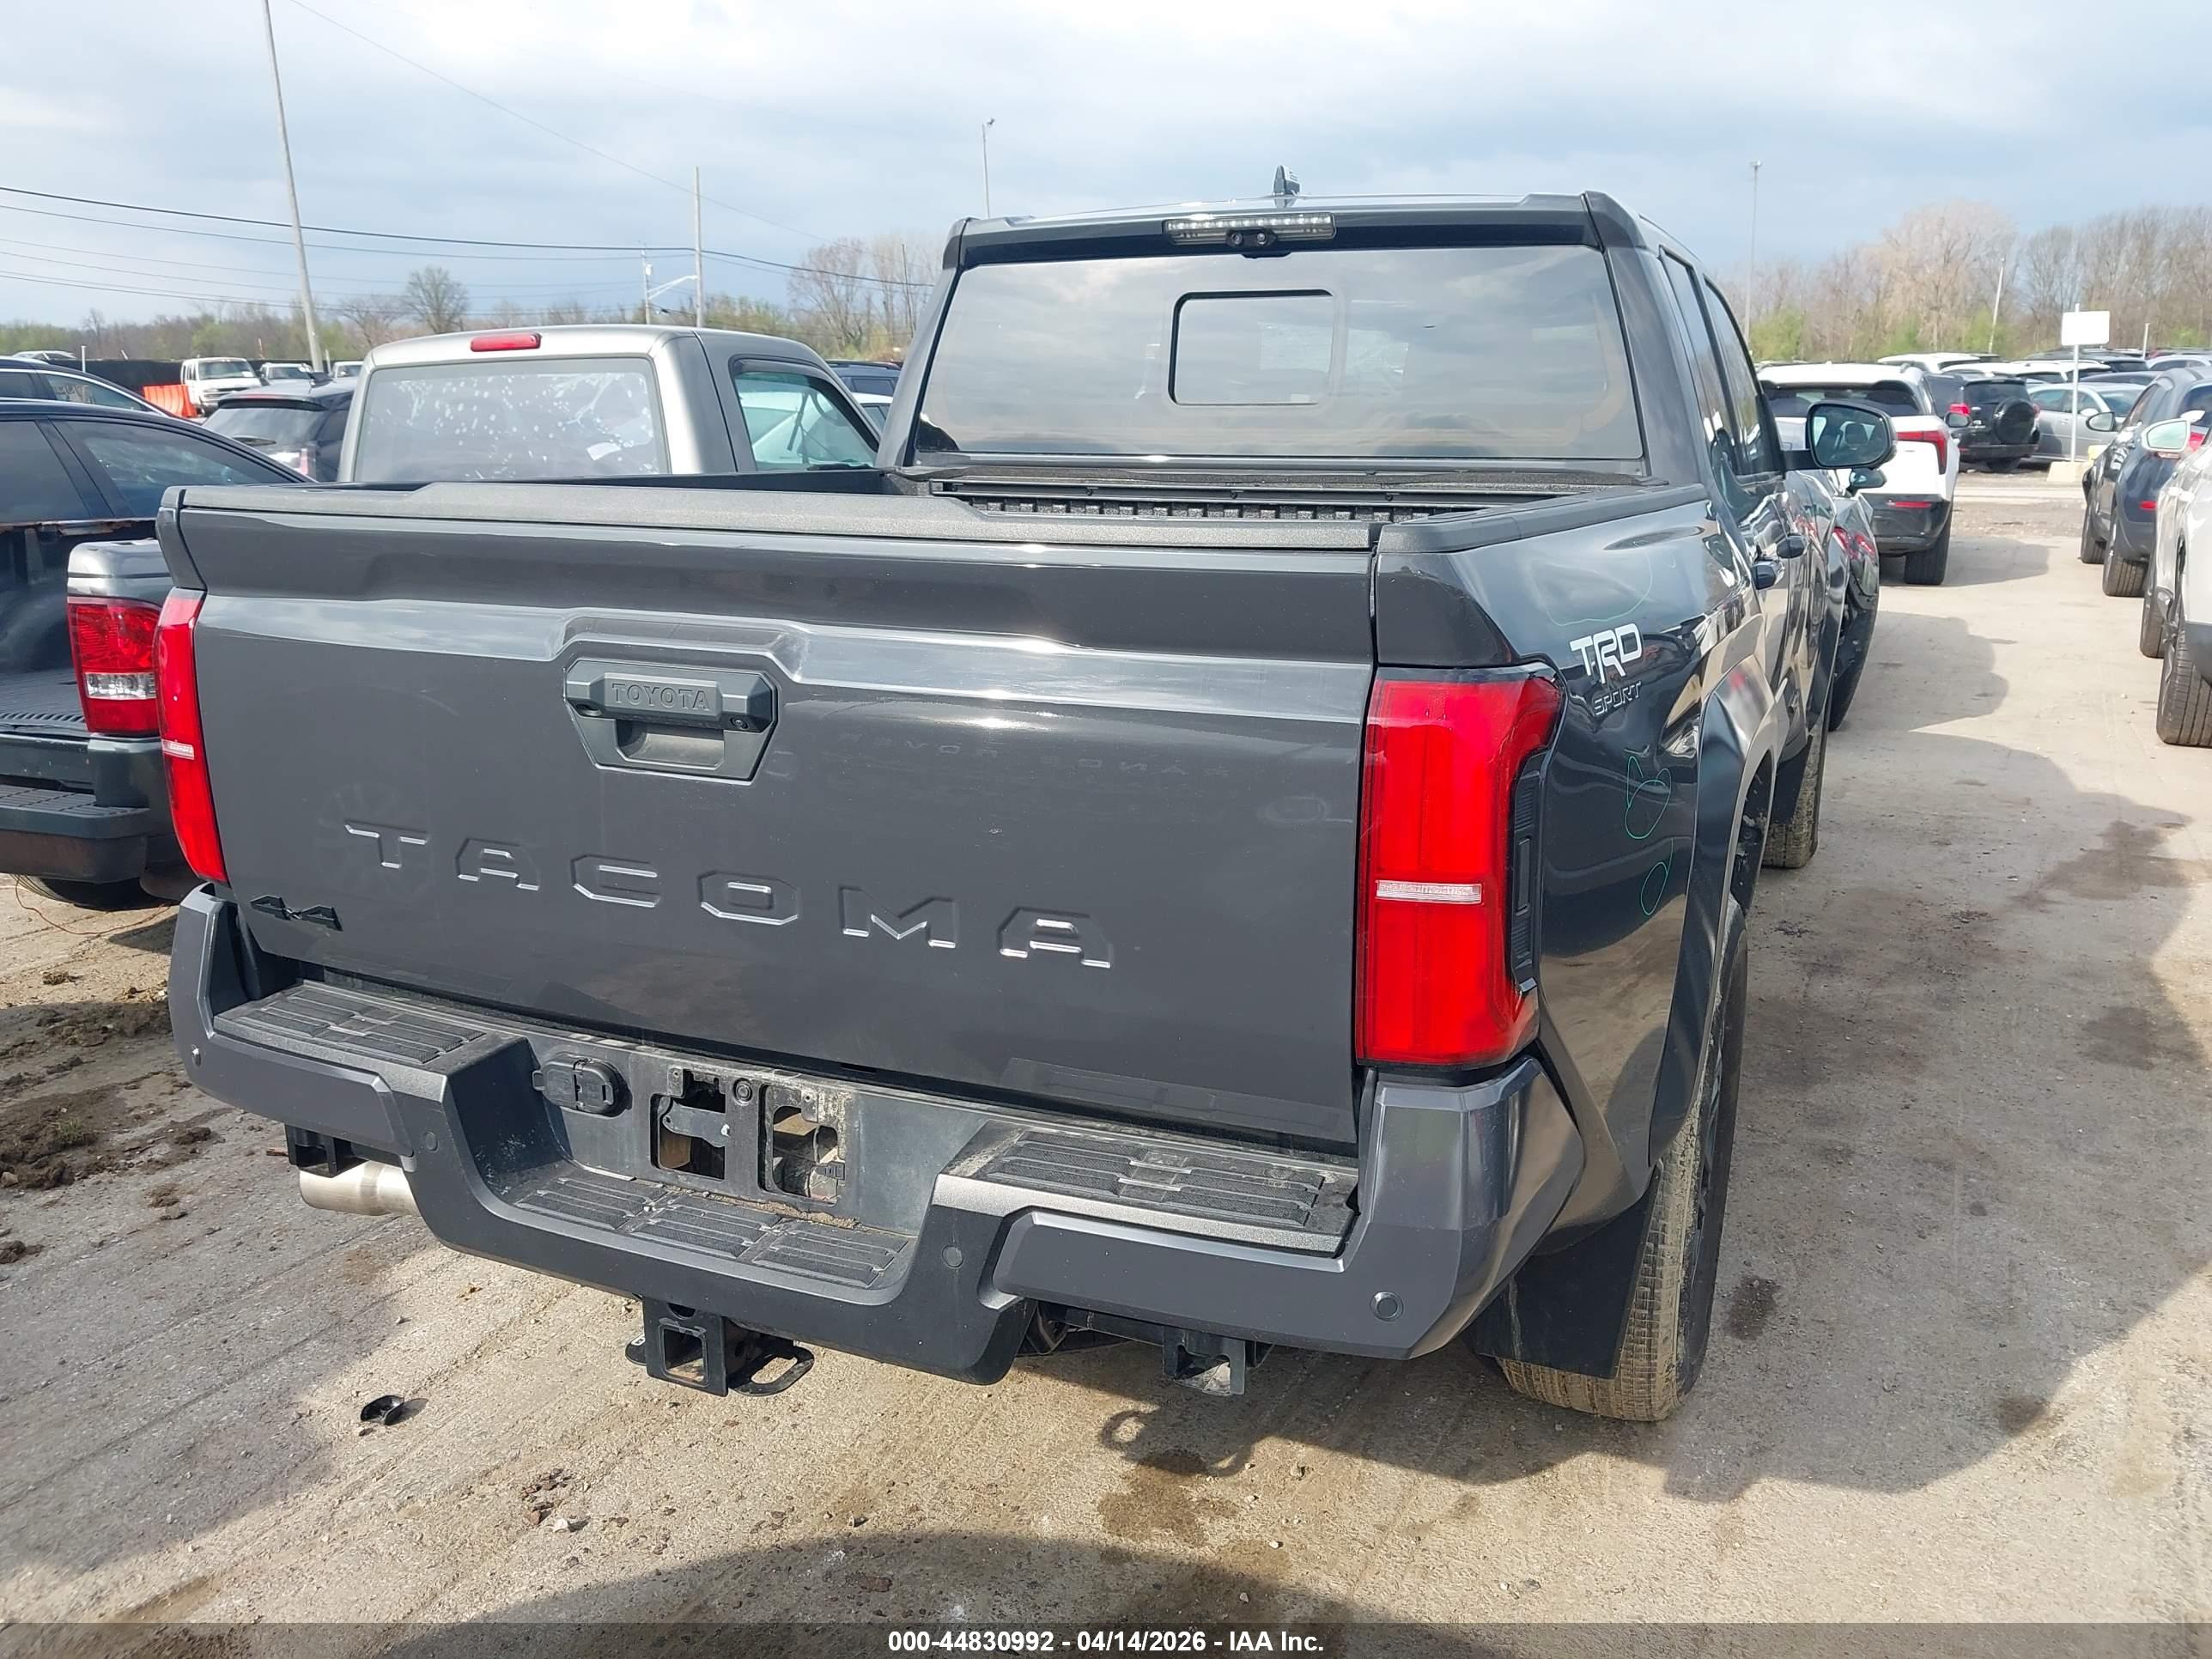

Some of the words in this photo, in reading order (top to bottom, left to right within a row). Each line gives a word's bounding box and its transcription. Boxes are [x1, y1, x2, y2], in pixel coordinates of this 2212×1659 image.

[1569, 623, 1643, 684] TRD
[611, 683, 710, 711] TOYOTA
[1594, 680, 1642, 716] SPORT
[344, 820, 1114, 969] TACOMA
